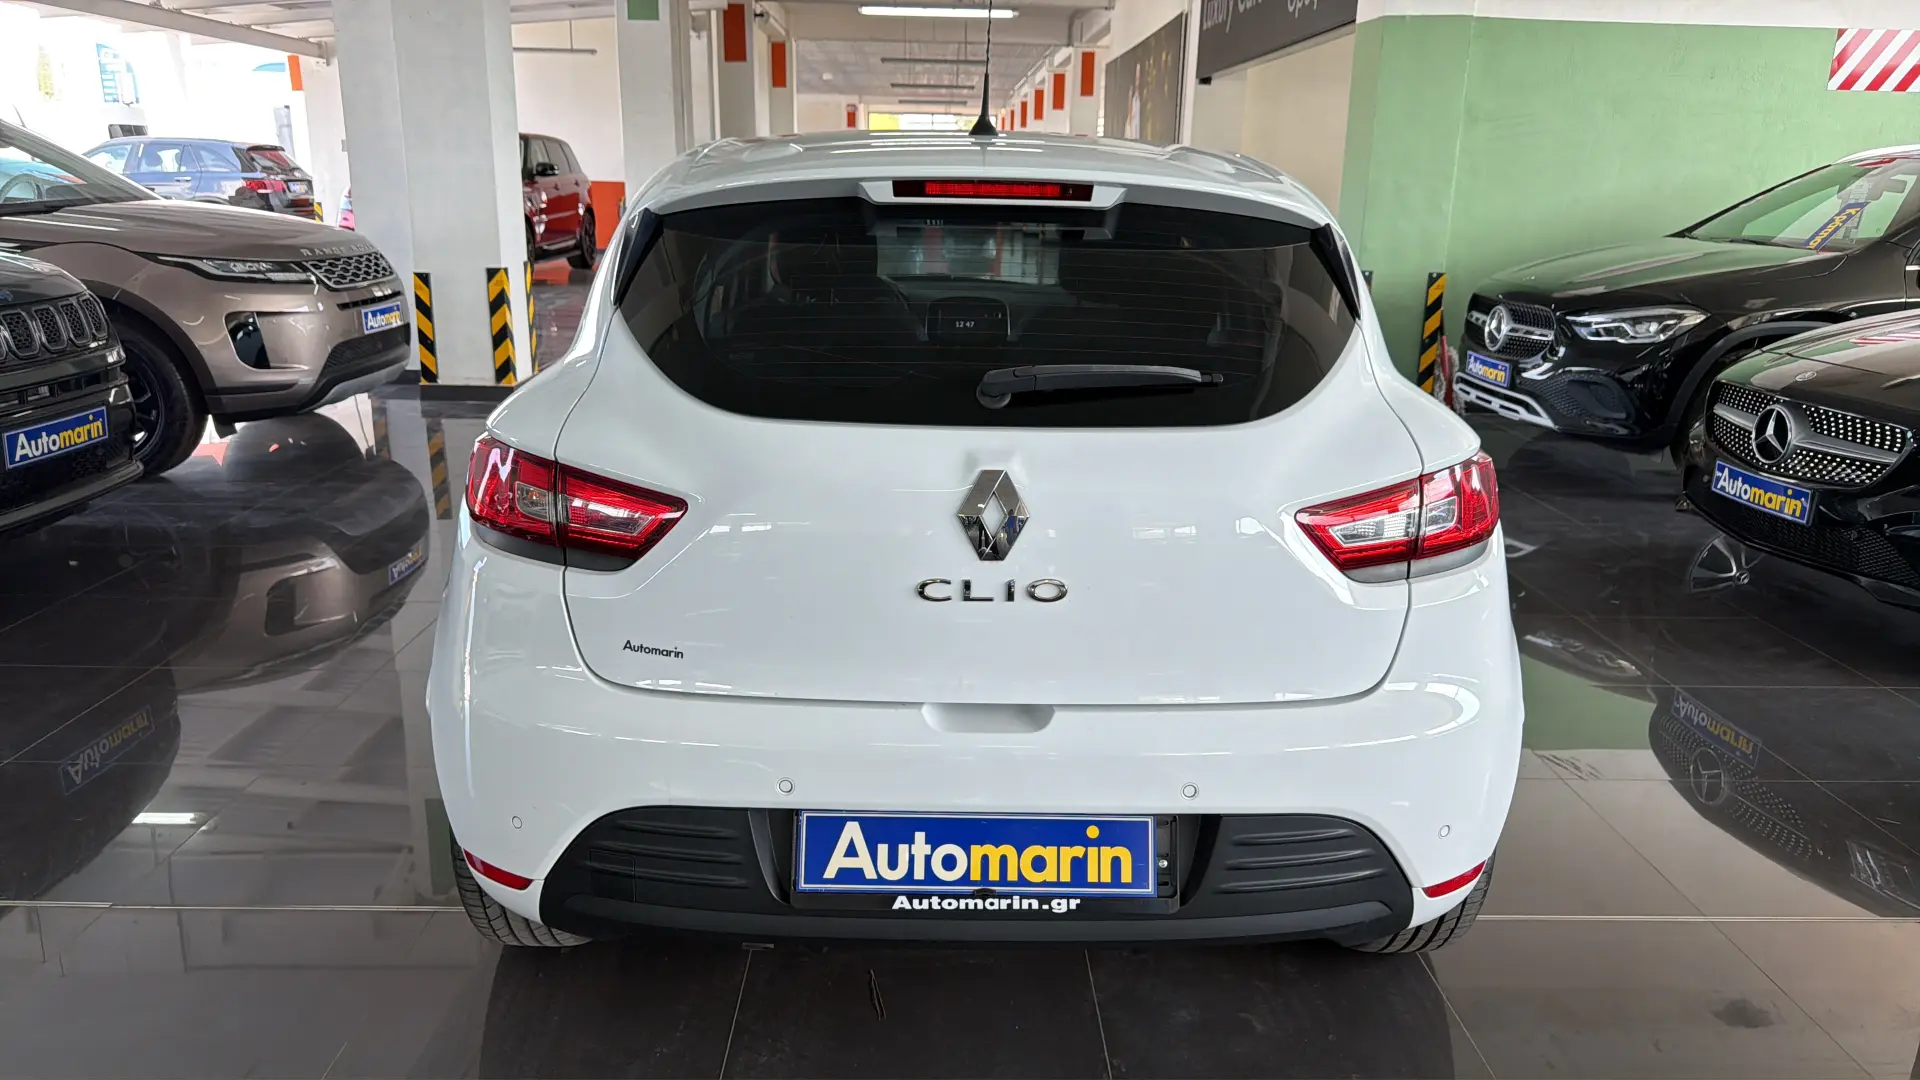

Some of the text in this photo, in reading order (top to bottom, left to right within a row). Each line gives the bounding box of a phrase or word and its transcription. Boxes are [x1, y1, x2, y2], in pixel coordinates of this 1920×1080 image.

[1468, 355, 1506, 384] Automarin
[15, 414, 103, 462] Automarin
[1716, 467, 1803, 518] Automarin
[916, 578, 1068, 602] CLIO
[622, 640, 684, 659] Automarin
[822, 820, 1133, 883] Automarin
[891, 895, 1081, 914] Automarin.gr
